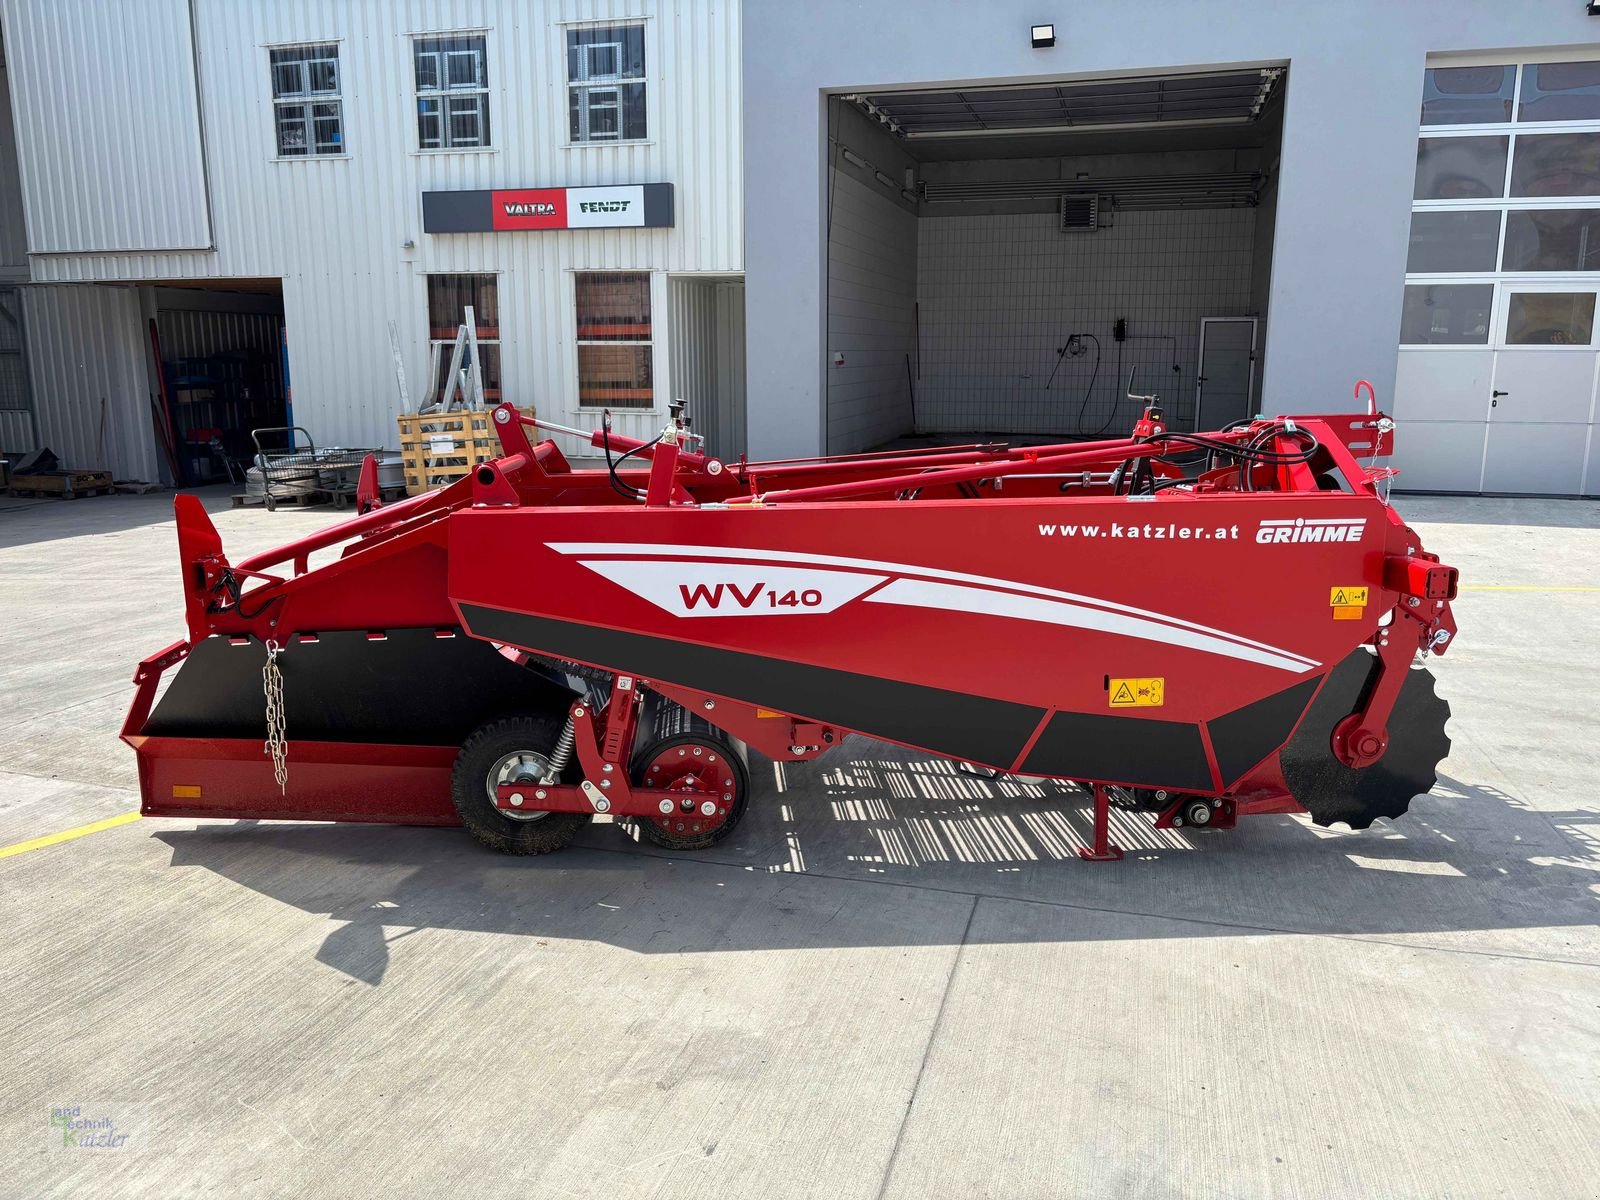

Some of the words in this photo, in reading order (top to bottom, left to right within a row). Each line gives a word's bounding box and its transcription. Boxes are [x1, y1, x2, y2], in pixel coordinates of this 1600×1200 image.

[504, 202, 556, 216] VALTRA
[579, 201, 631, 213] FENDT
[1038, 523, 1239, 539] www.katzler.at
[1255, 518, 1366, 543] GRIMME
